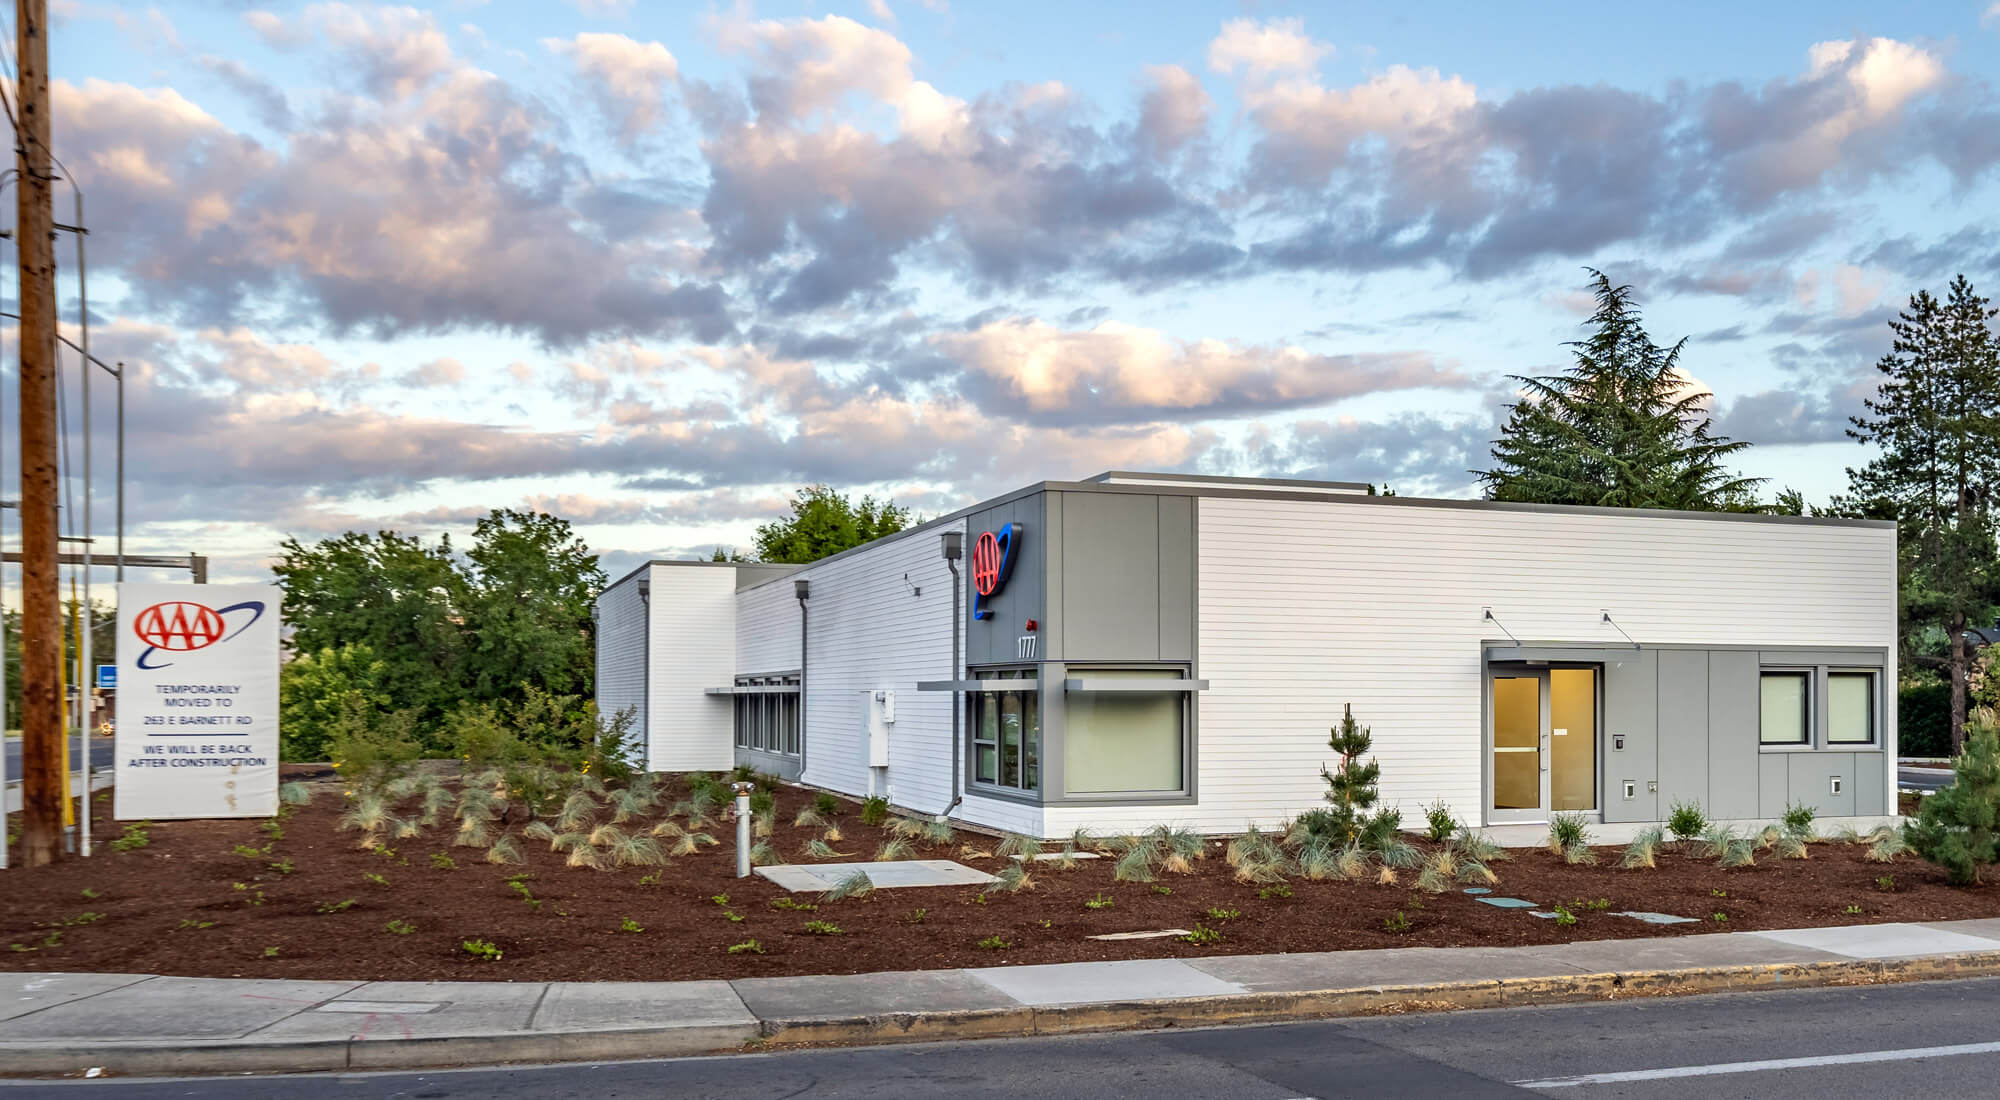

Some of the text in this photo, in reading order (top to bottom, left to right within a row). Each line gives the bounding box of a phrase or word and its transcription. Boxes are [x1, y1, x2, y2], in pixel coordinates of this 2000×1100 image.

[140, 603, 221, 650] AAA
[1018, 635, 1038, 659] 1777
[155, 684, 241, 694] TEMPORARILY
[164, 698, 233, 708] MOVED TO
[143, 715, 253, 725] 263 E BARNETT RD
[143, 744, 253, 754] WE WILL BE BACK
[128, 757, 267, 768] AFTER CONSTRUCTION
